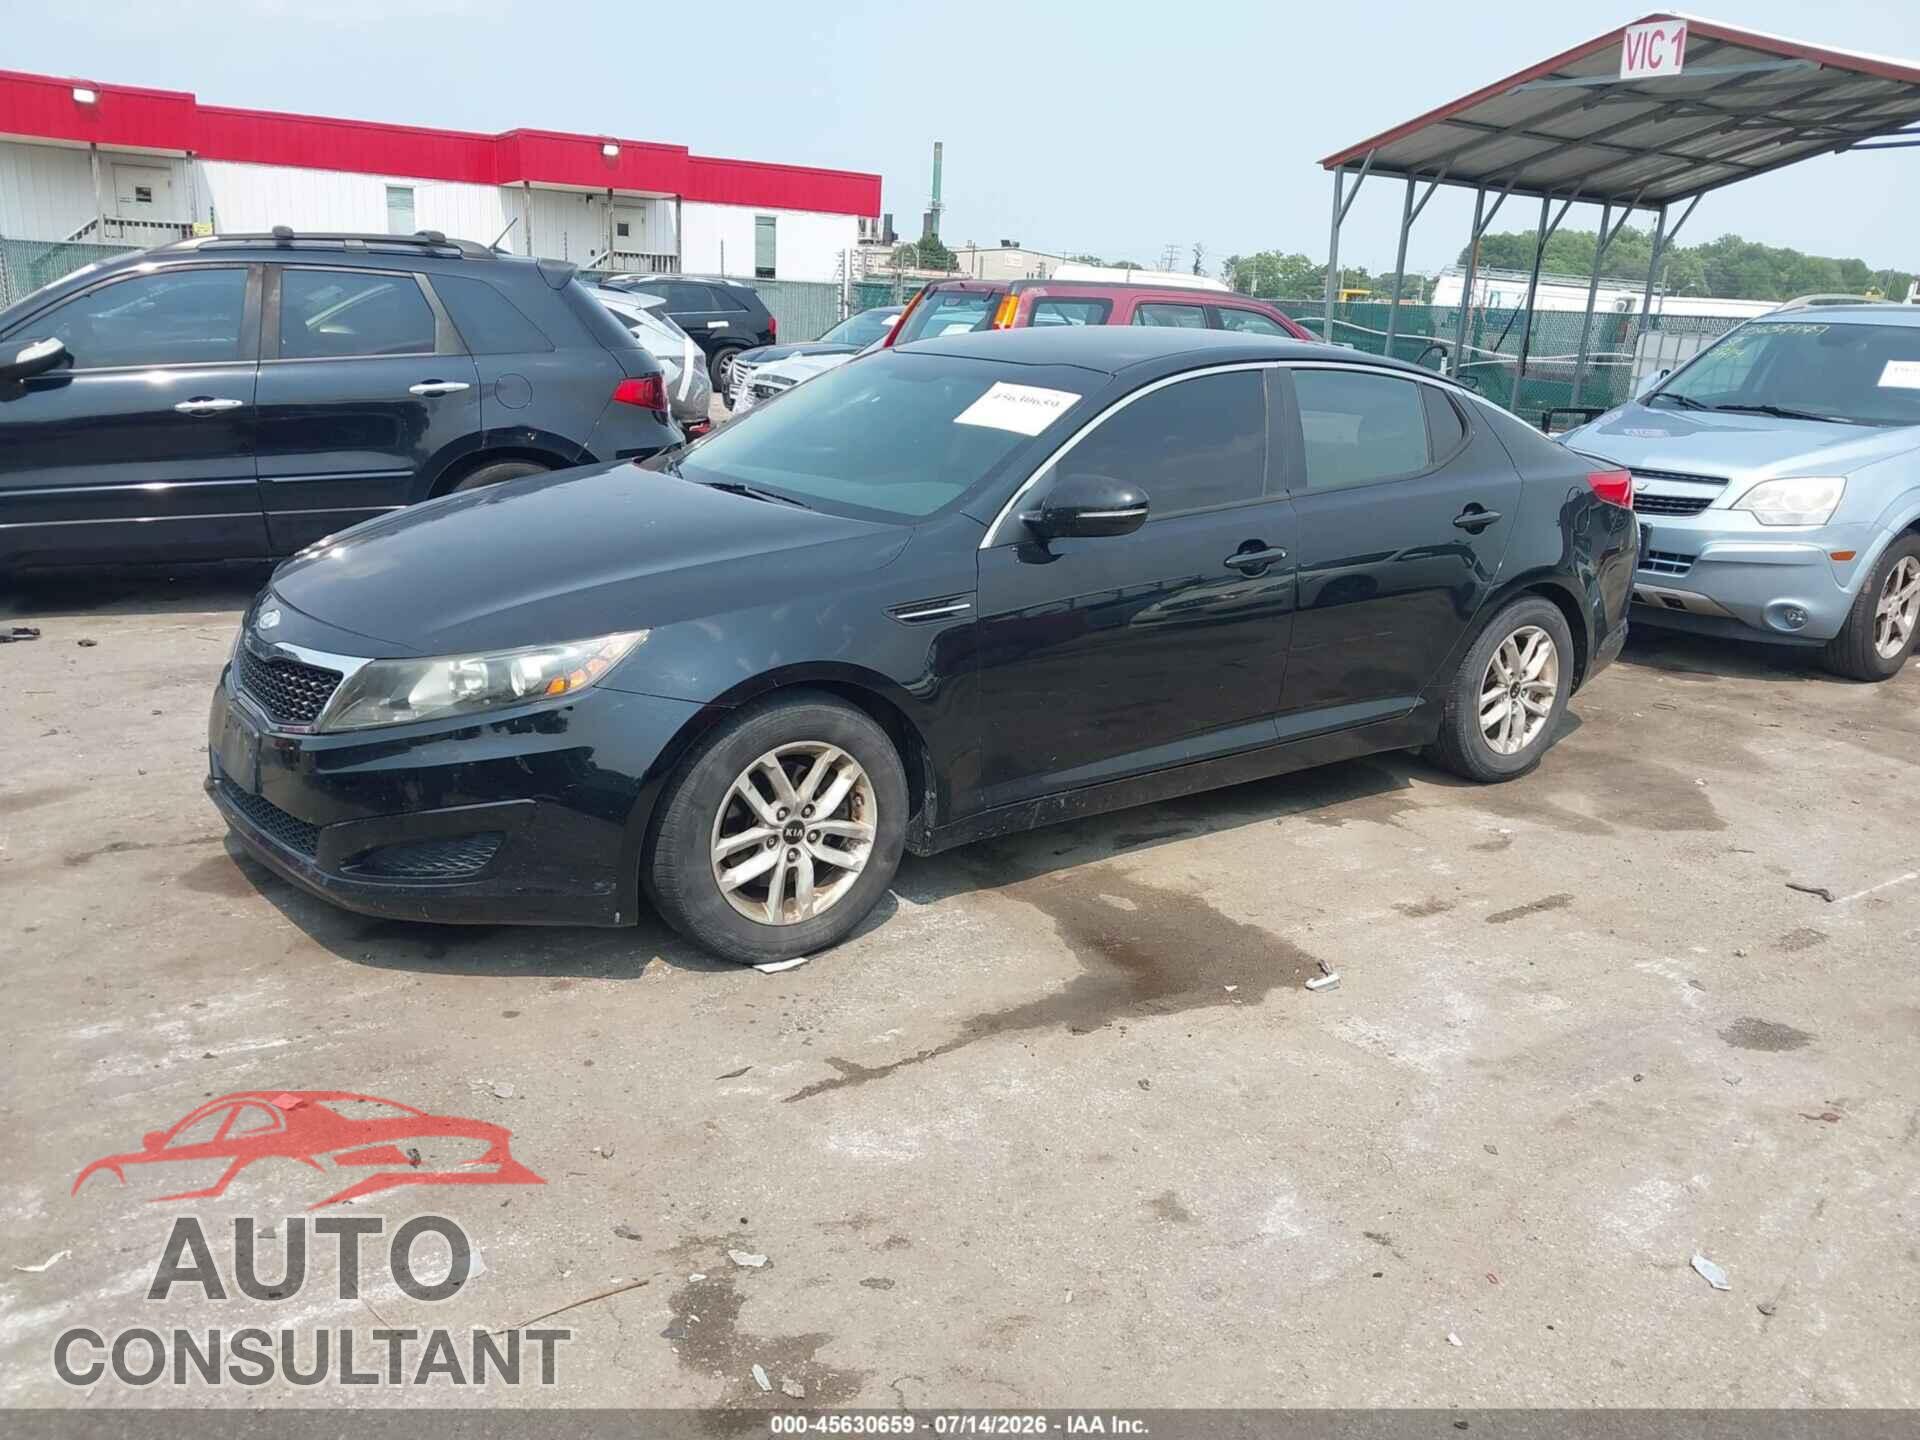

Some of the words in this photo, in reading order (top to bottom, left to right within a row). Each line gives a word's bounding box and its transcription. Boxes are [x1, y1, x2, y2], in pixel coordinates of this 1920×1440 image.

[1627, 29, 1665, 71] VIC
[1671, 26, 1685, 66] 1
[785, 828, 803, 837] KIA
